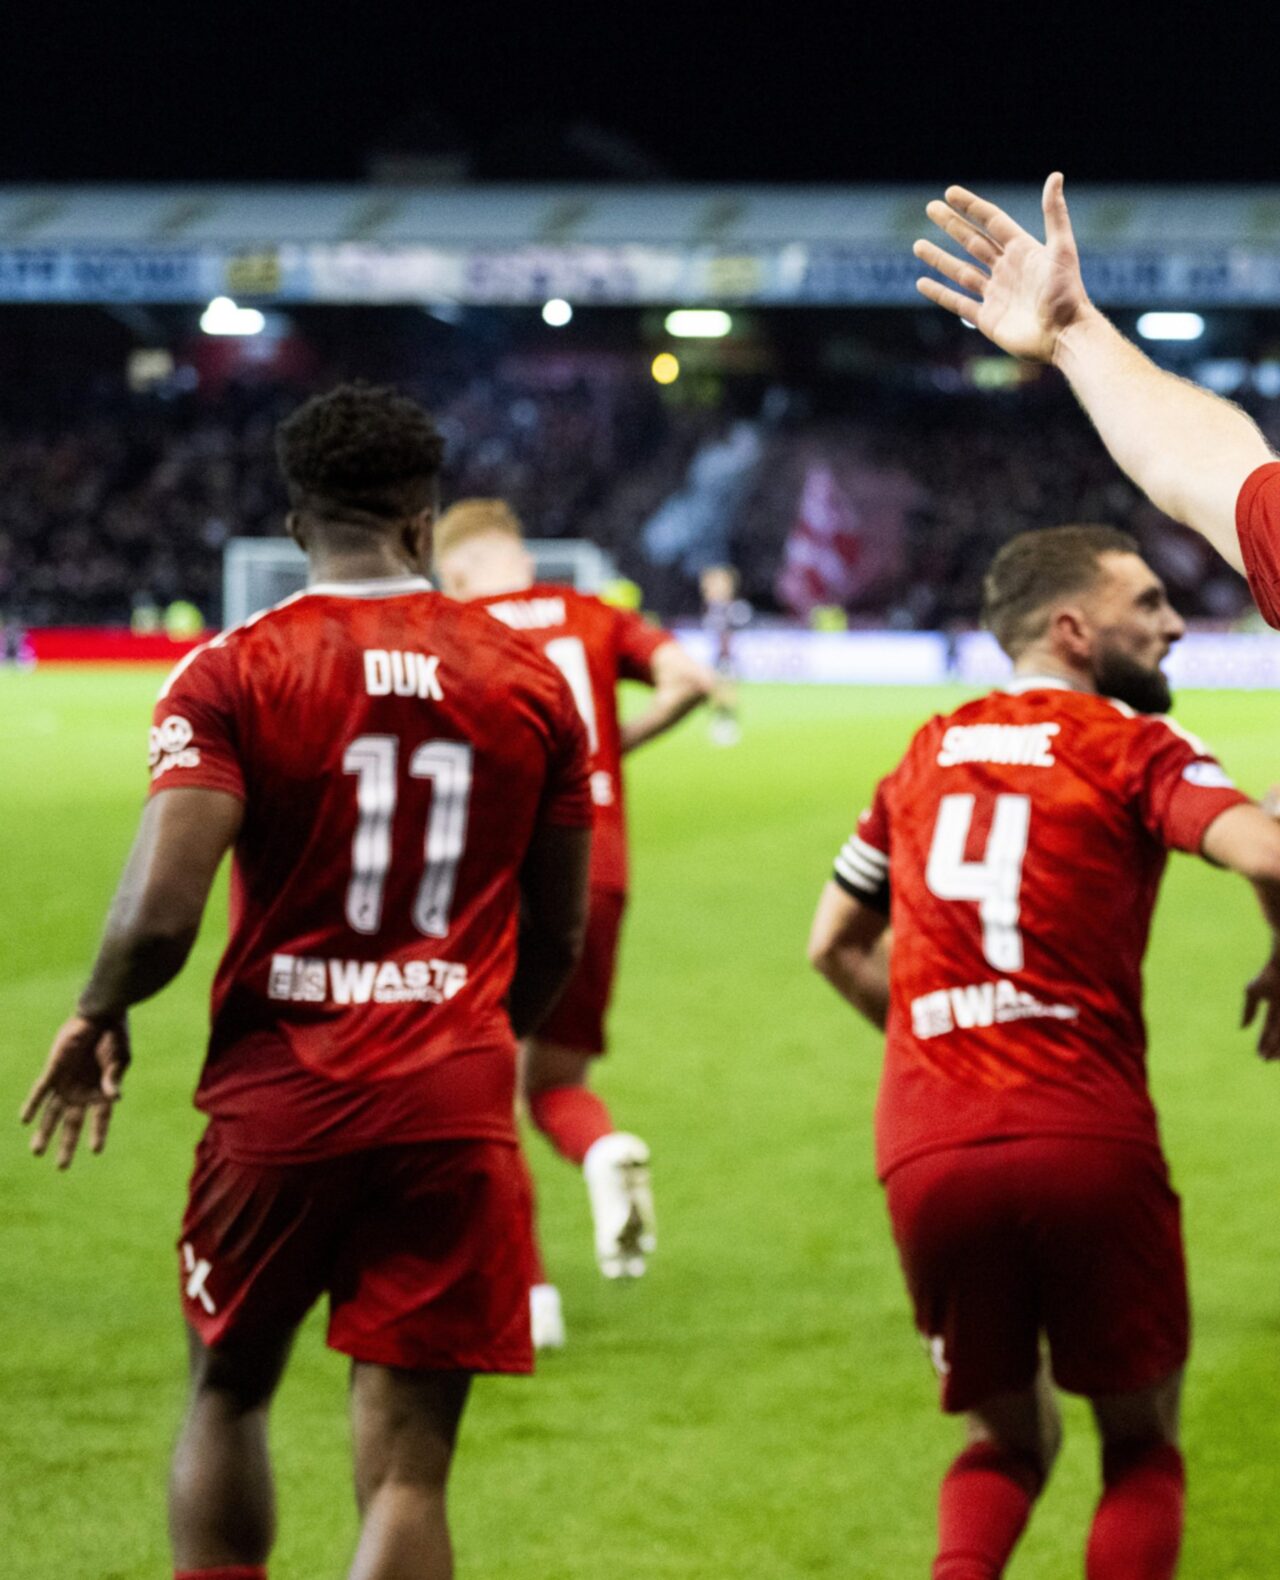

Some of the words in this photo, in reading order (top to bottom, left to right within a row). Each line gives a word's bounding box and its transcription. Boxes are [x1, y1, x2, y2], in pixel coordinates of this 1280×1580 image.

[363, 649, 445, 701] DUK
[342, 733, 474, 938] 11
[925, 792, 1031, 973] 4
